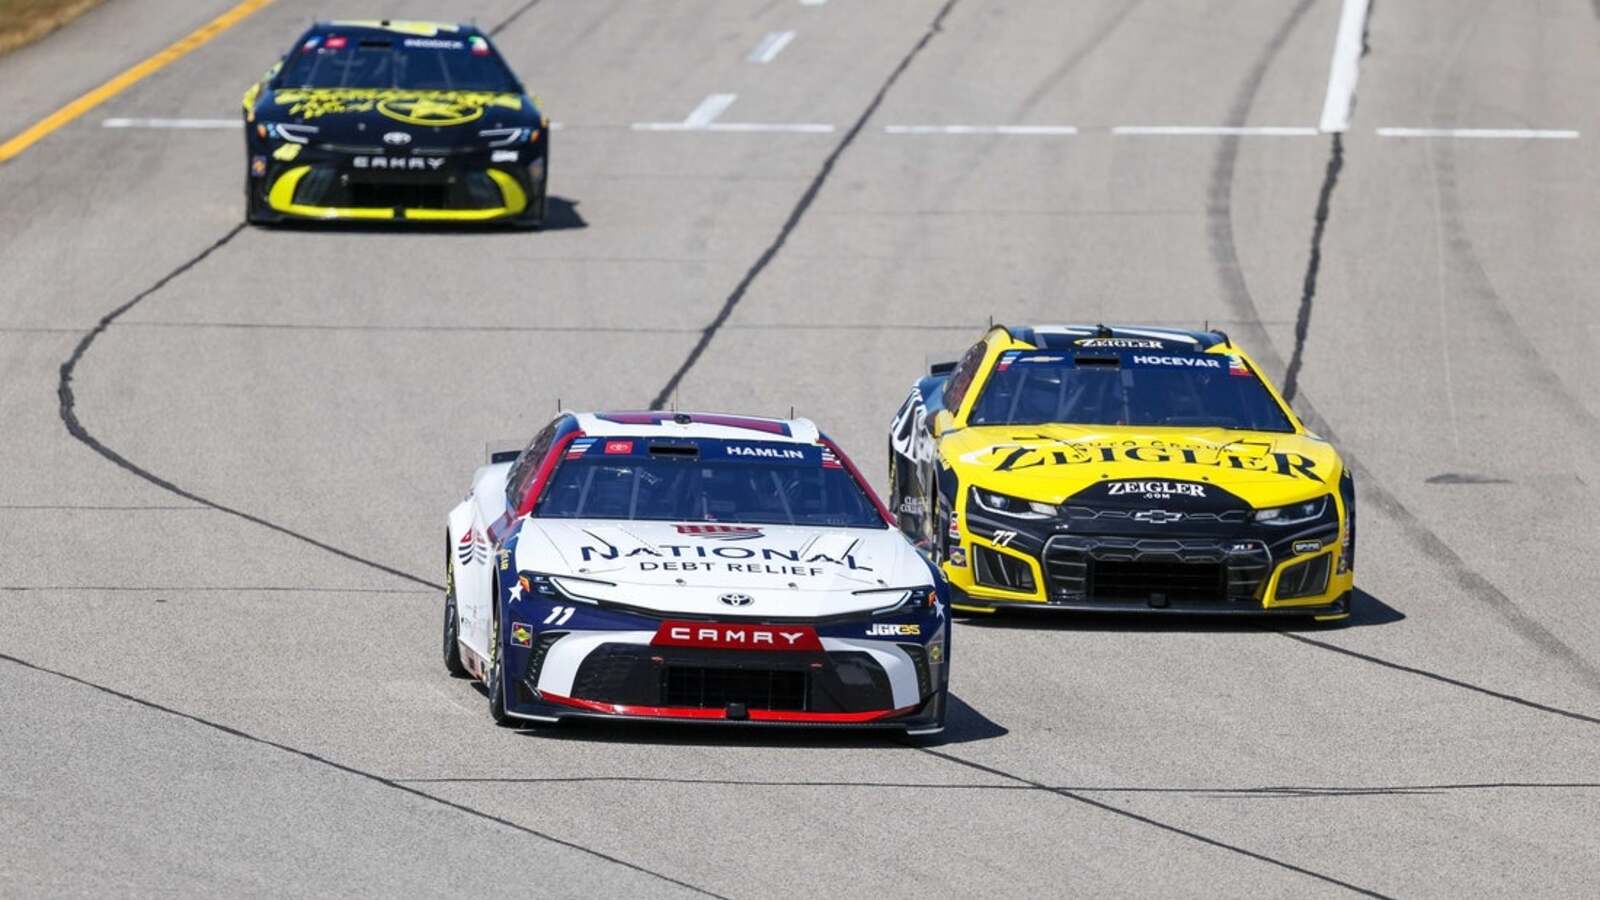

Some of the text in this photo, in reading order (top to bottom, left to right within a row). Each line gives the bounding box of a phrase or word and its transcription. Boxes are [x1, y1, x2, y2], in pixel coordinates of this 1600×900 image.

[1080, 338, 1163, 349] ZEIGLER
[1133, 355, 1220, 368] HOCEVAR
[726, 445, 804, 460] HAMLIN
[991, 444, 1327, 484] ZEIGLER
[1107, 481, 1207, 497] ZEIGLER
[992, 530, 1017, 547] 77
[580, 545, 873, 572] NATIONAL
[640, 561, 825, 577] DEBT RELIEF
[543, 606, 576, 626] 11
[670, 627, 805, 645] CAMRY
